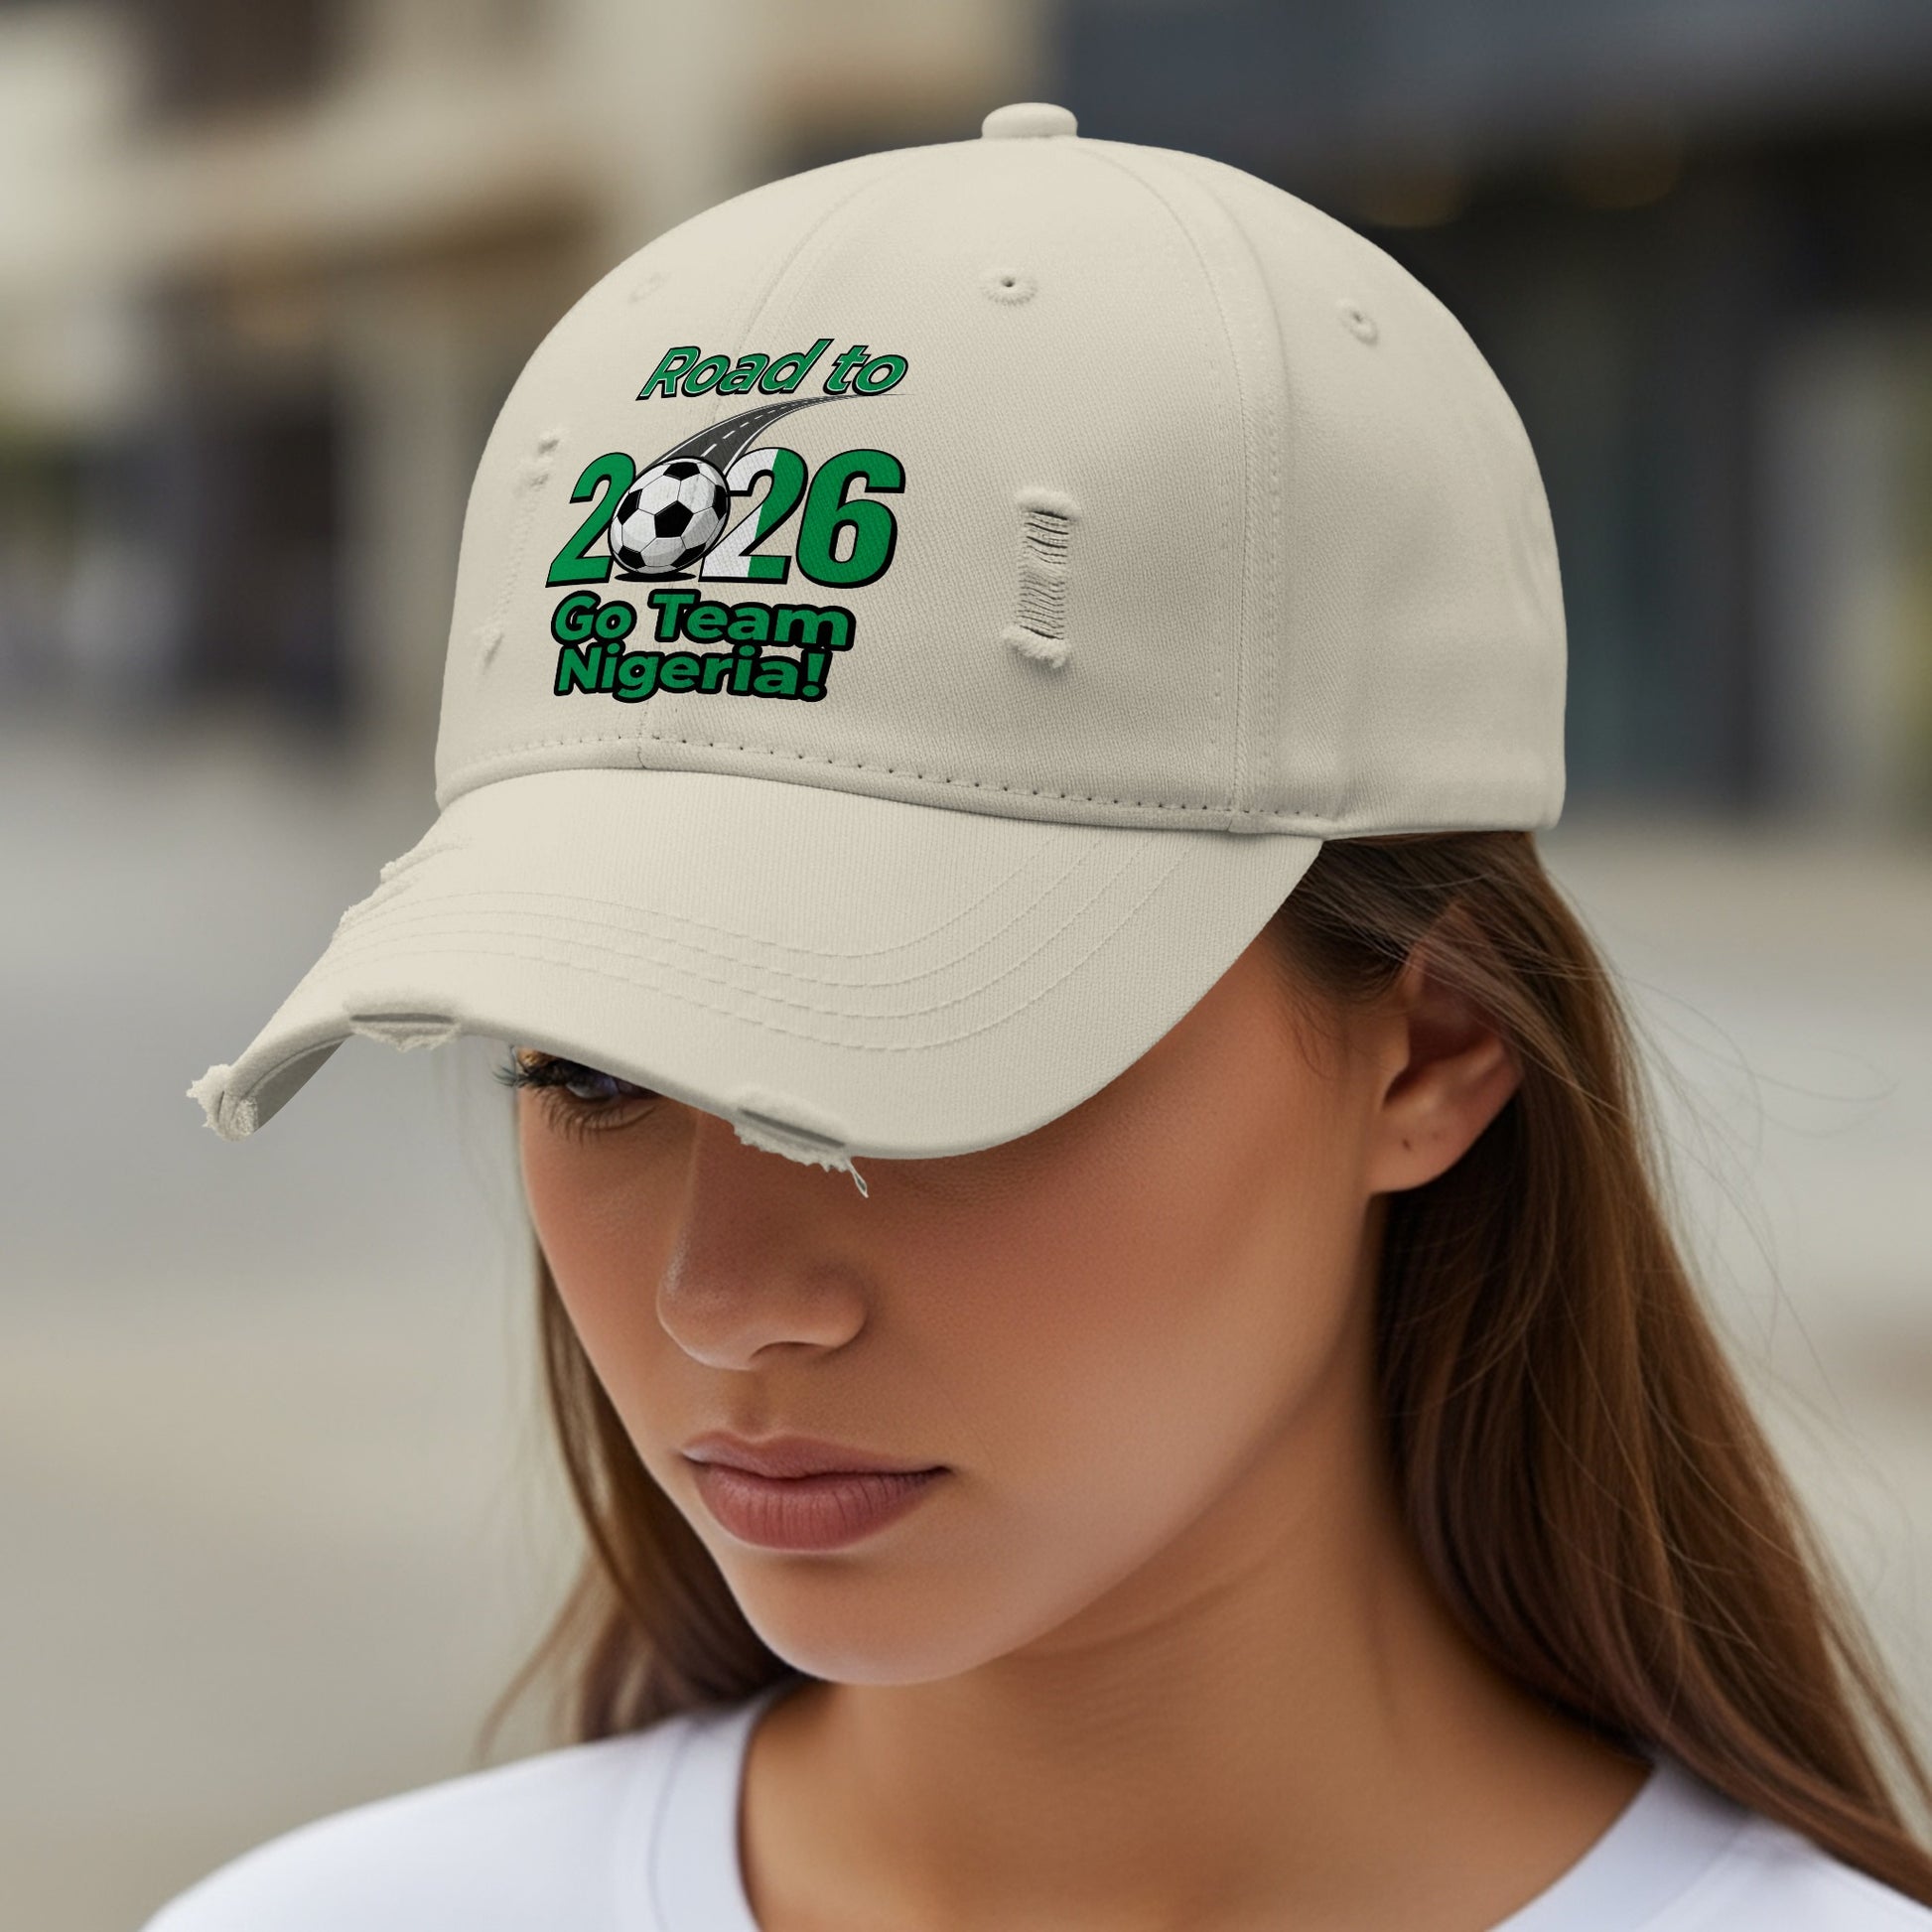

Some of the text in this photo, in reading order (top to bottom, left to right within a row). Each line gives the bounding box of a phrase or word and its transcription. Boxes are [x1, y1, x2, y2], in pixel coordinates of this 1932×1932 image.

[635, 339, 909, 401] Road to
[545, 447, 906, 589] 2026
[551, 588, 857, 651] Go Team
[554, 642, 834, 703] Nigeria!
